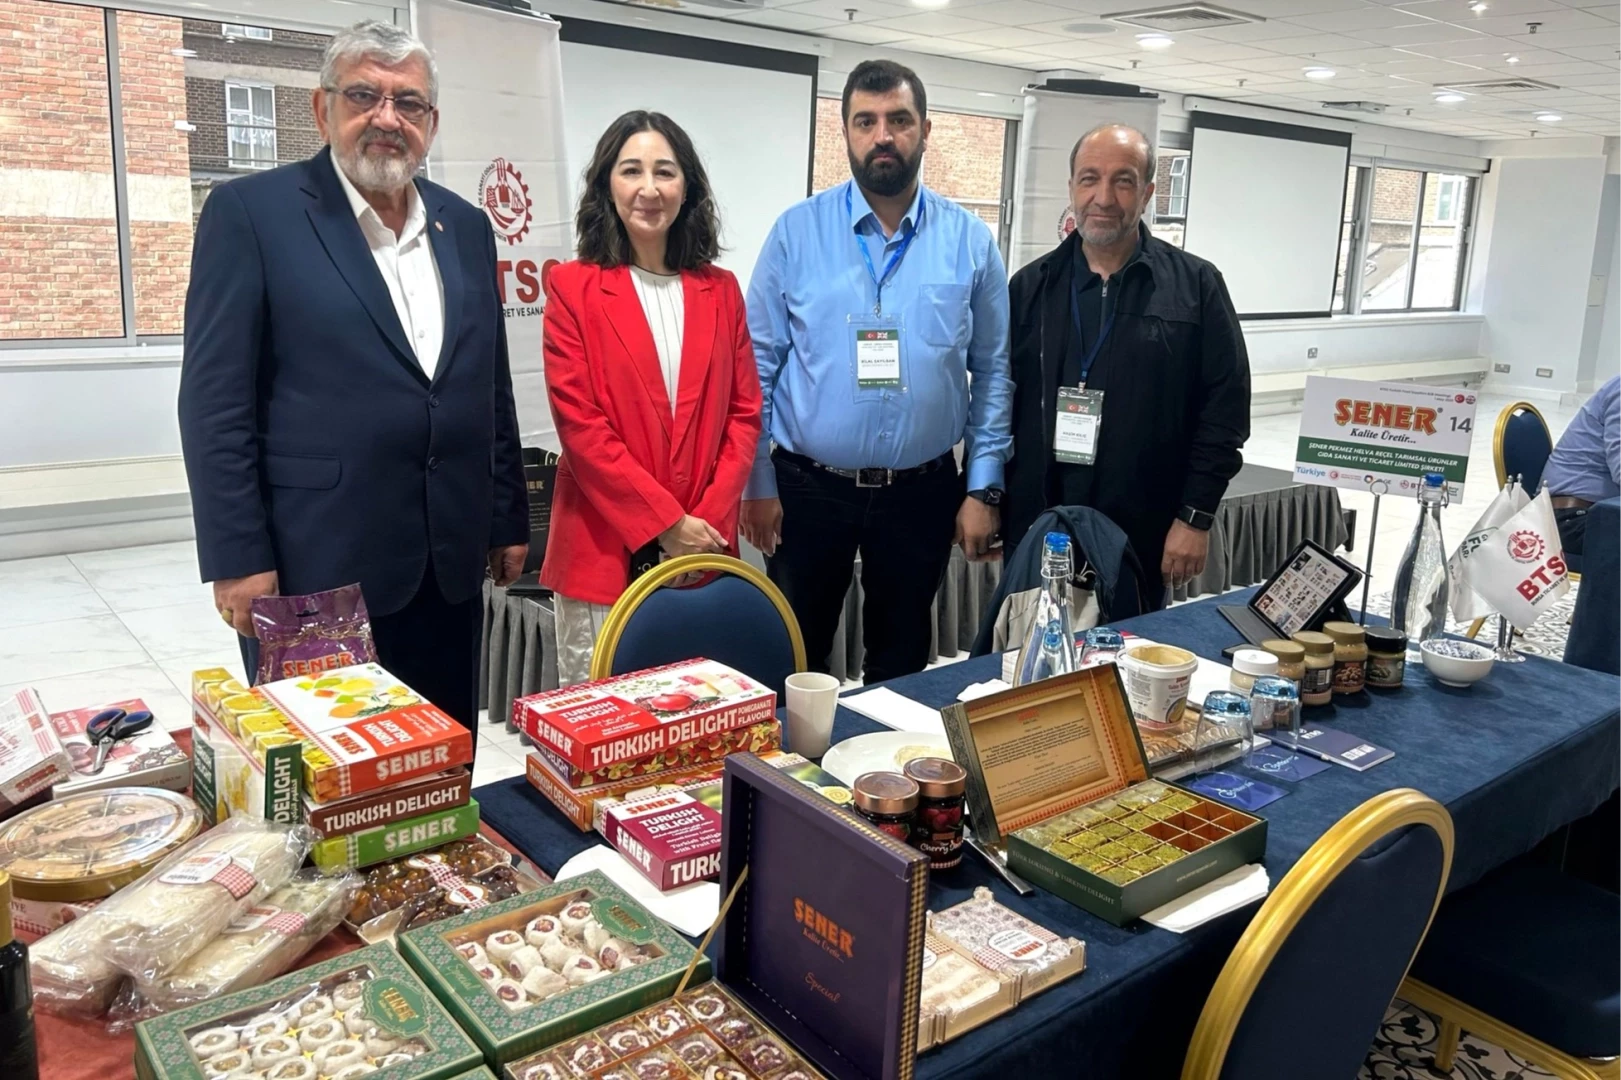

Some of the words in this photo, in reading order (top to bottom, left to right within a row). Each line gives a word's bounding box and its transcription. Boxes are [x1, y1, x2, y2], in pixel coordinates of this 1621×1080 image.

[516, 307, 526, 317] VE
[1450, 416, 1471, 433] 14
[1350, 428, 1378, 439] Kalite
[1381, 430, 1416, 444] Üretir...
[1317, 451, 1333, 459] GIDA
[1334, 453, 1358, 462] SANAYİ
[1368, 457, 1393, 467] TİCARET
[1394, 460, 1420, 469] LİMİTED
[1328, 444, 1353, 453] PEKMEZ
[1354, 447, 1374, 456] HELVA
[1375, 450, 1393, 459] REÇEL
[1394, 452, 1426, 462] TARIMSAL
[1427, 456, 1458, 466] ÜRÜNLER
[1295, 466, 1326, 478] Türkiye
[559, 701, 615, 719] TURKISH
[566, 706, 620, 724] DELIGHT
[738, 699, 772, 716] POMEGRANATE
[738, 709, 771, 726] FLAVOUR
[591, 729, 664, 767] TURKISH
[669, 708, 738, 745] DELIGHT
[273, 757, 291, 823] DELIGHT
[529, 763, 553, 794] TURKISH
[553, 786, 580, 819] DELIGHT
[324, 806, 391, 833] TURKISH
[396, 785, 462, 815] DELIGHT
[638, 807, 699, 827] TURKISH
[647, 814, 705, 834] DELIGHT
[920, 842, 949, 854] Cherry
[1087, 887, 1115, 905] DELIGHT
[804, 971, 841, 1003] Special
